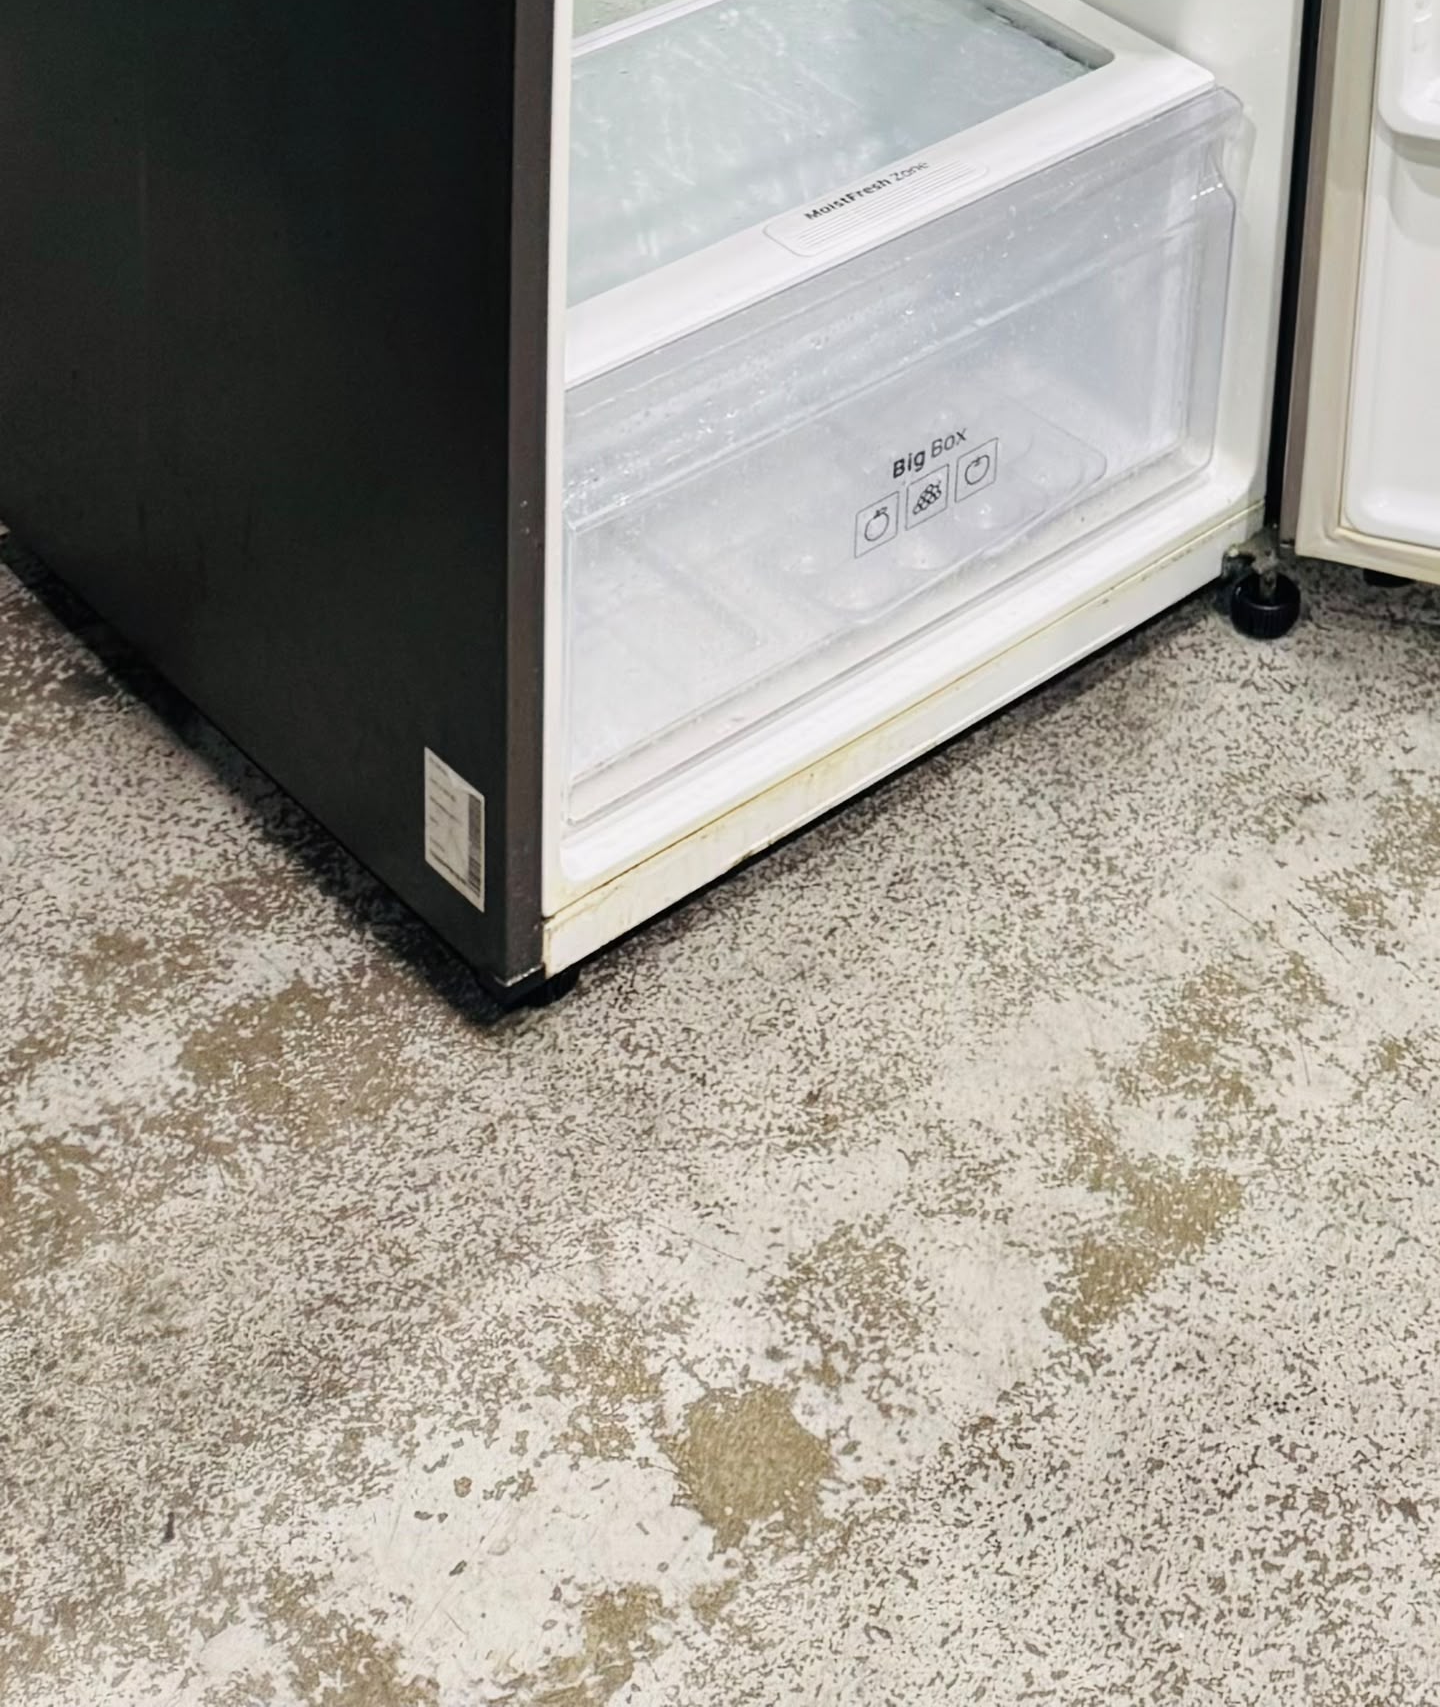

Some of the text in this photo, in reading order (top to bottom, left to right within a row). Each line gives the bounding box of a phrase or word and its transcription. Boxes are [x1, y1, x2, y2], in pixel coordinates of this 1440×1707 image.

[804, 160, 930, 221] MoistFresh Zone
[893, 427, 968, 479] Big Box
